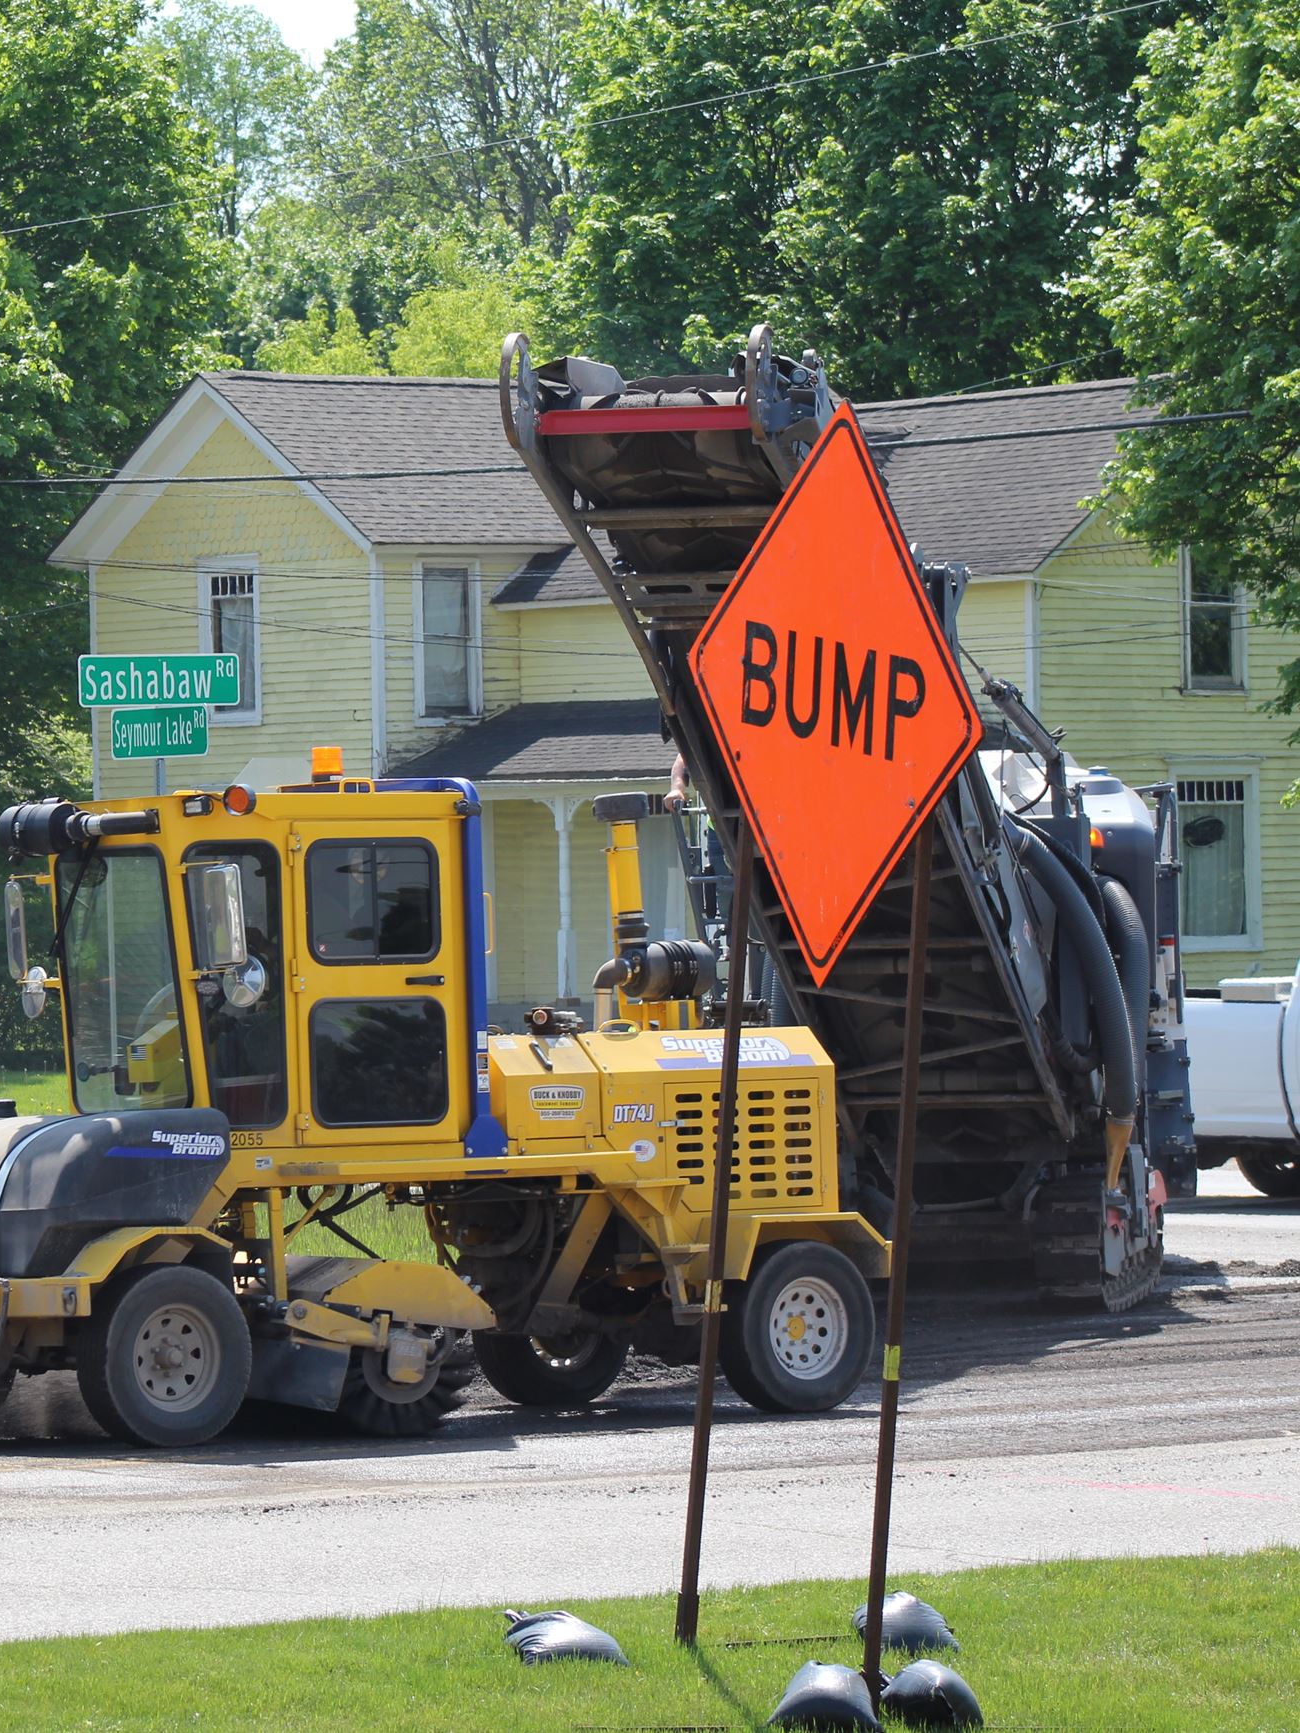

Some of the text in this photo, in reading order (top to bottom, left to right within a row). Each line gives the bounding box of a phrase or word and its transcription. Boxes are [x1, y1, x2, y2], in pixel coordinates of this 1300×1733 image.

[85, 658, 234, 700] Sashabaw Rd
[741, 620, 926, 762] BUMP
[115, 708, 205, 756] Seymour Lake Rd
[533, 1091, 550, 1099] BUCK
[557, 1090, 581, 1099] KNOBBY
[613, 1104, 654, 1122] DT74J
[151, 1130, 217, 1145] Superior
[231, 1132, 263, 1146] 2055
[172, 1143, 220, 1156] Broom
